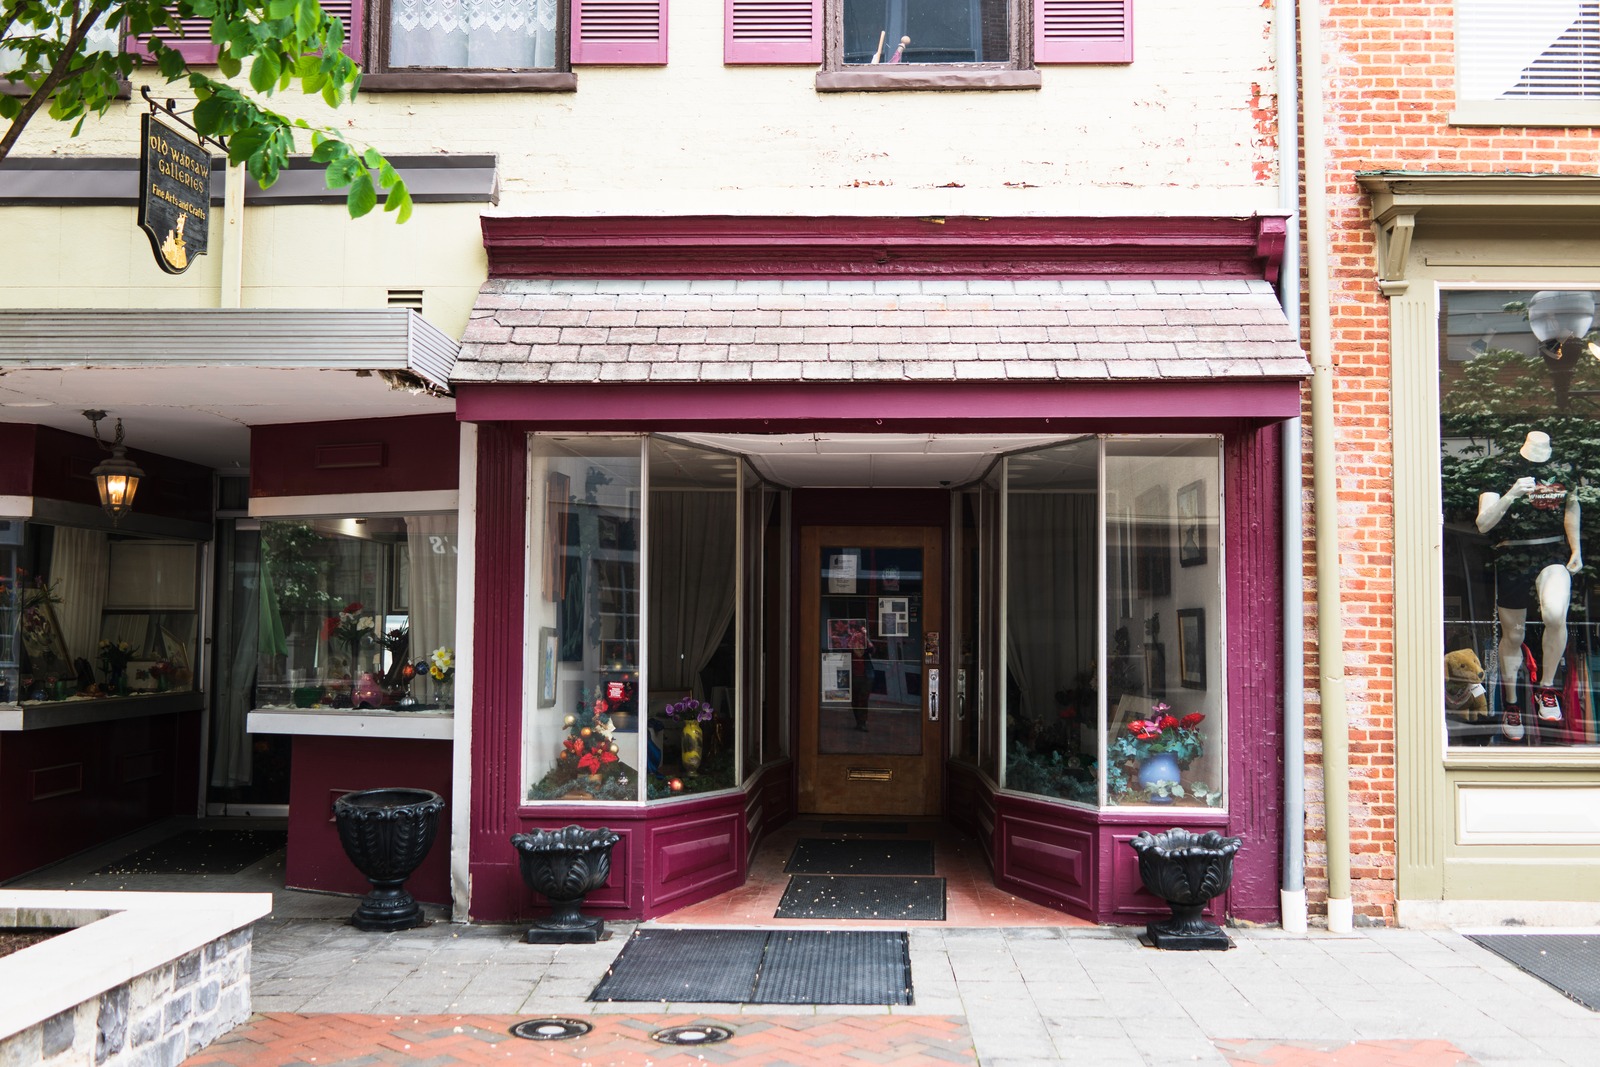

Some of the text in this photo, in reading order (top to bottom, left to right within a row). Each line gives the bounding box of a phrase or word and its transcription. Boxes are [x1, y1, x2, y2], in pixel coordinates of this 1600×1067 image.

[152, 183, 206, 220] Fine Arts and Crafts
